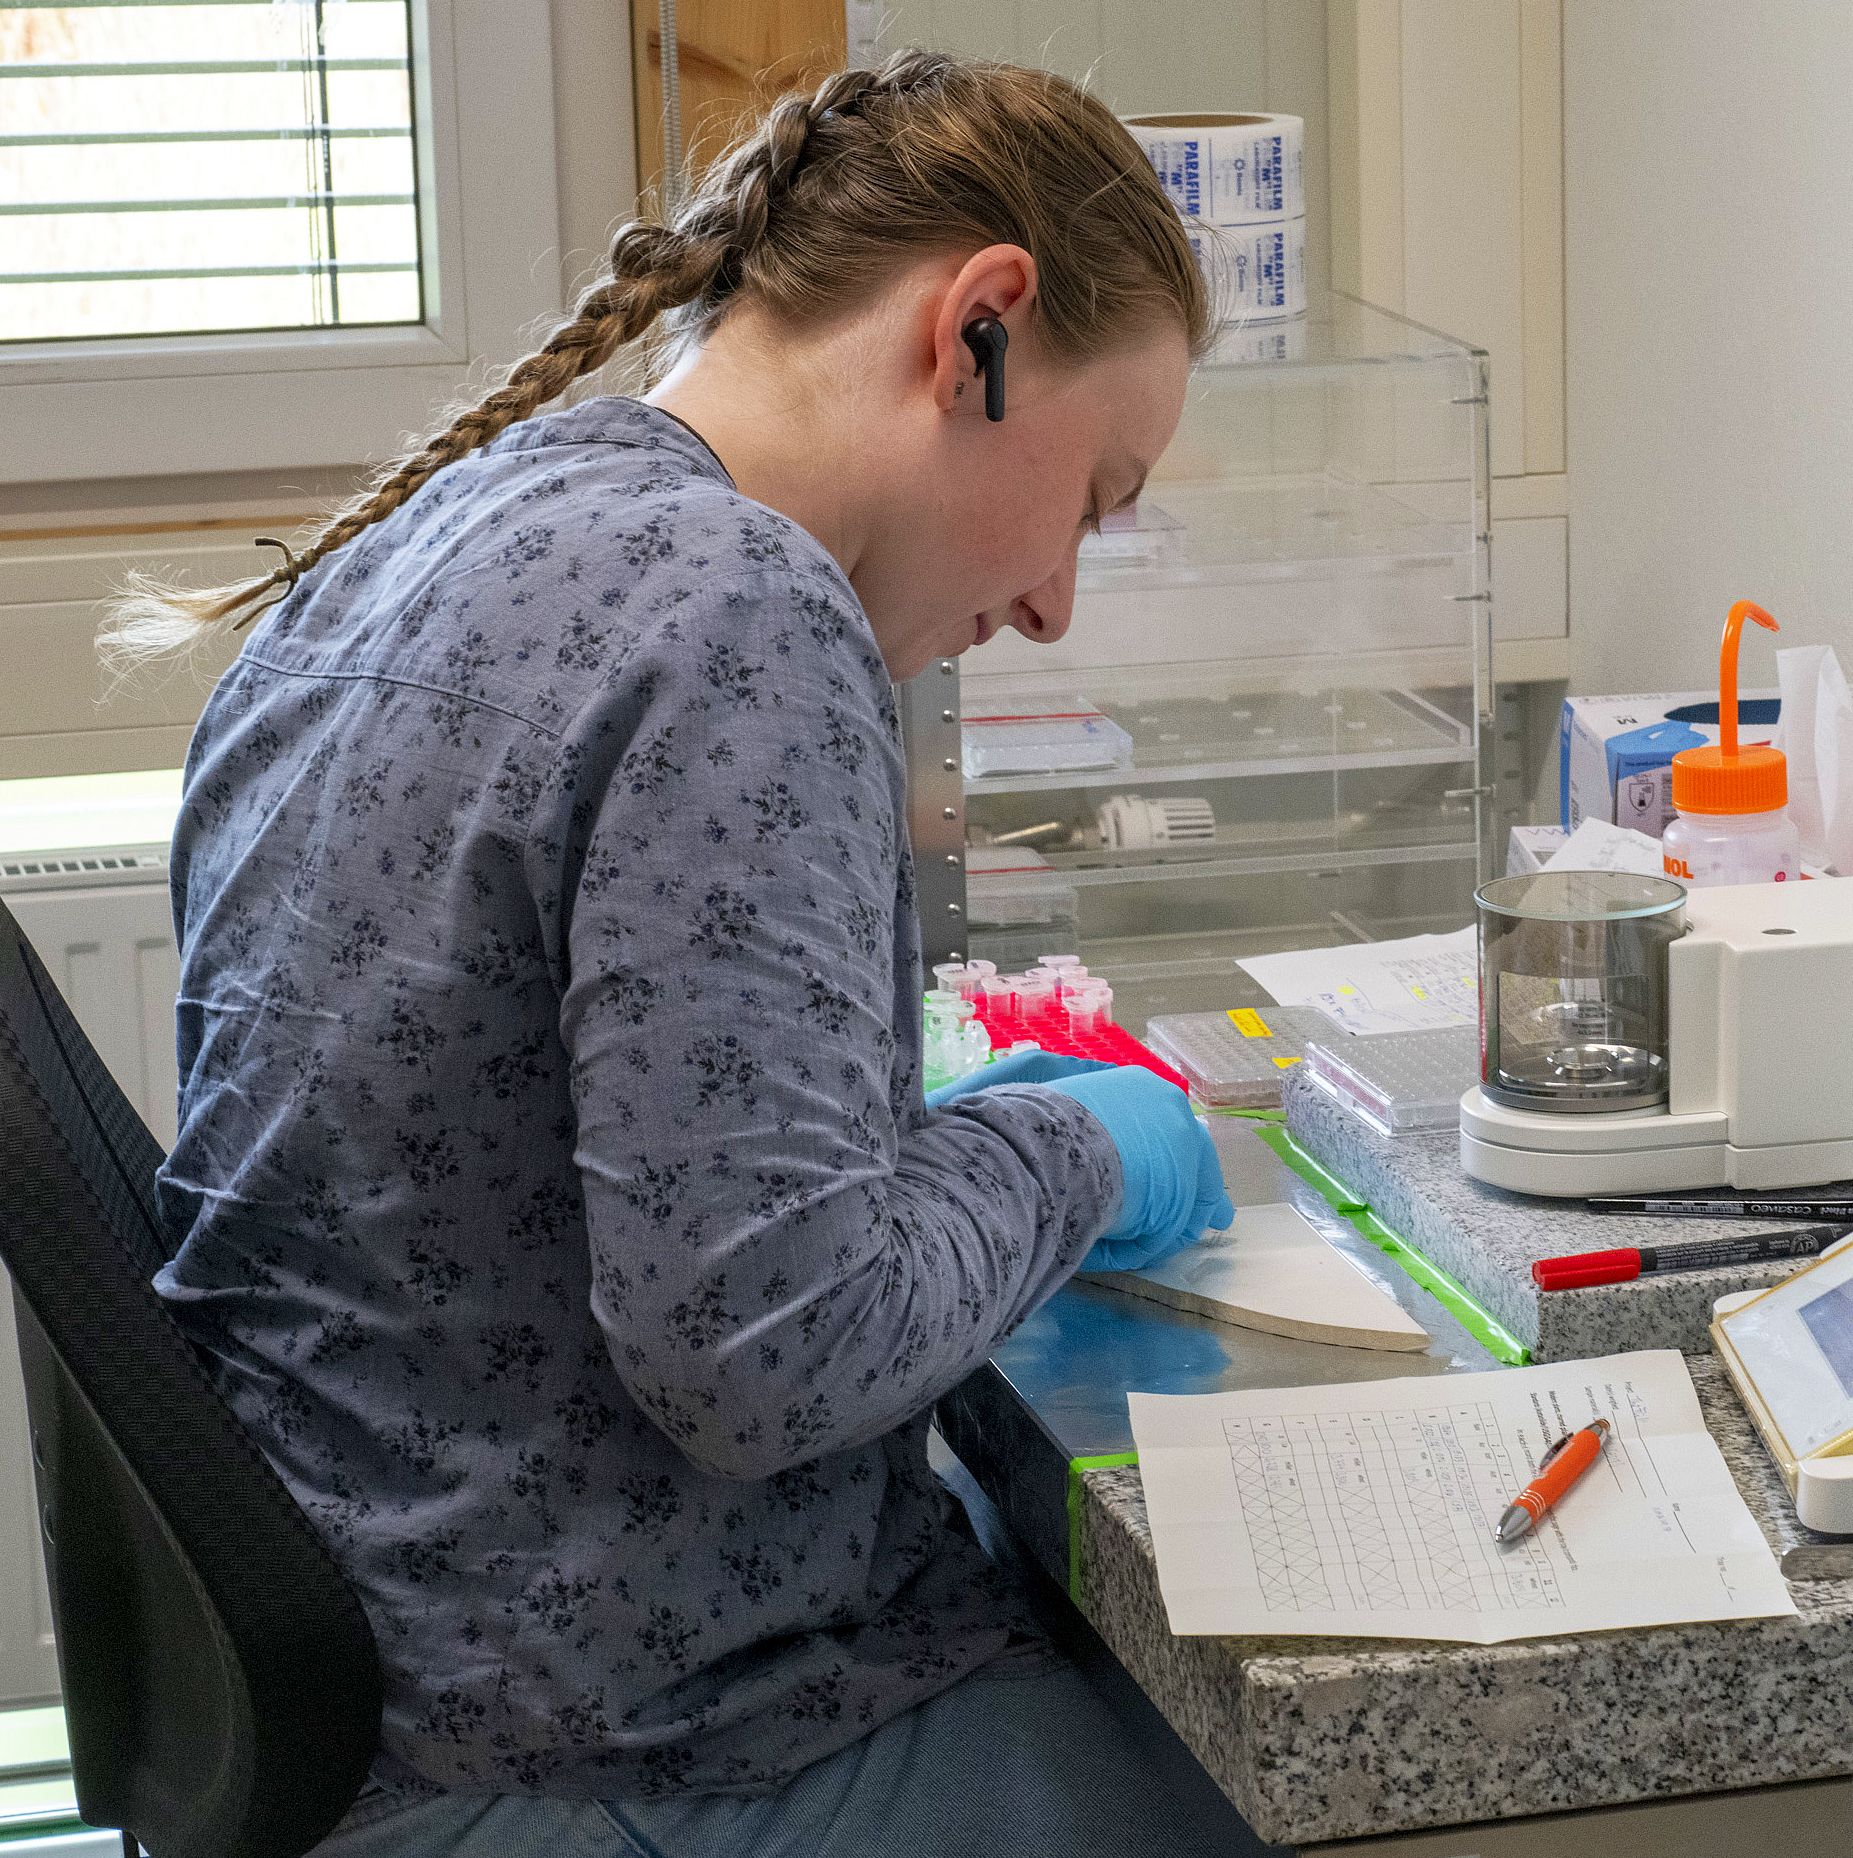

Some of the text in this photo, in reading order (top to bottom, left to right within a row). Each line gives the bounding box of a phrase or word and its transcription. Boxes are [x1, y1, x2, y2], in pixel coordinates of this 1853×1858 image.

[1185, 141, 1200, 215] PARAFILM
[1272, 136, 1283, 211] PARAFILM
[1274, 232, 1285, 306] PARAFILM
[1750, 1203, 1811, 1214] casaneo
